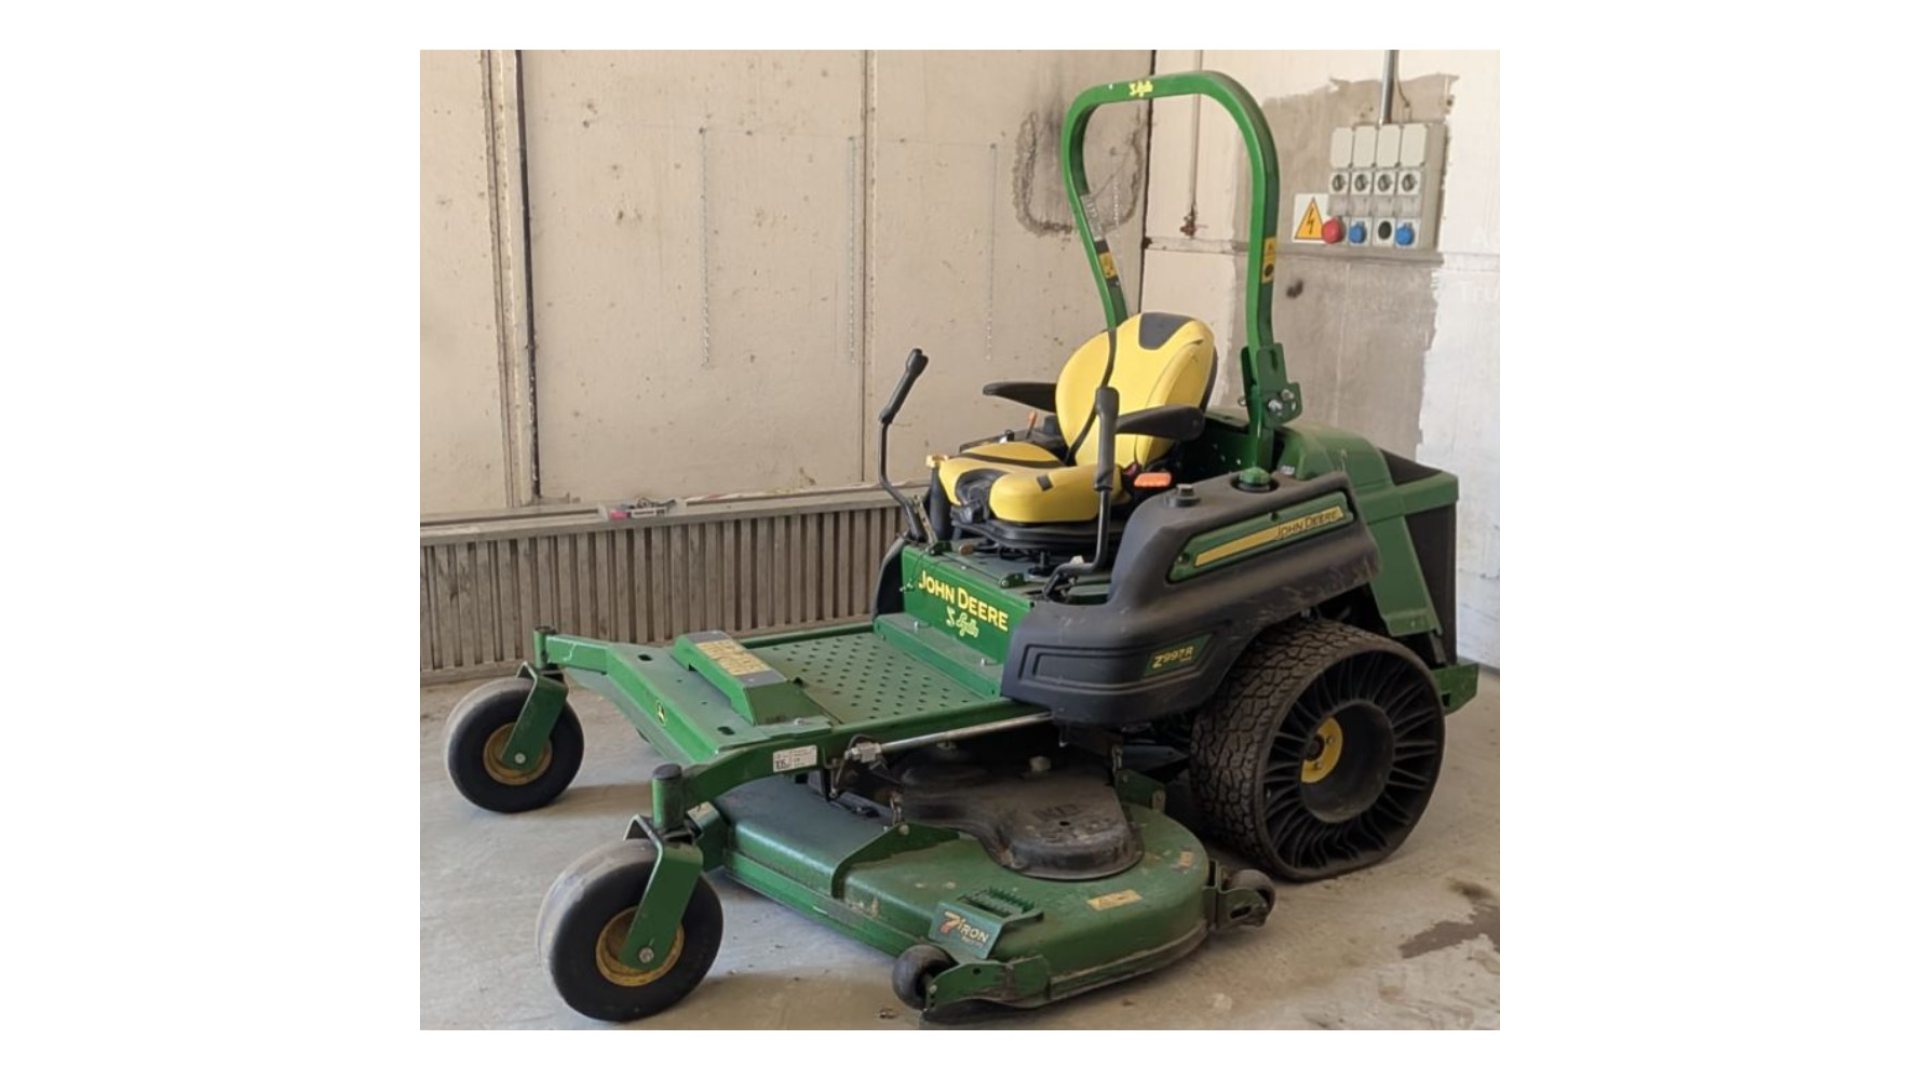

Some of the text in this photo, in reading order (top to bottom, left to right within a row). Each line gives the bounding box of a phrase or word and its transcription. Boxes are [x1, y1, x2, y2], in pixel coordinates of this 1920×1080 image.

[1275, 510, 1340, 539] JOHN DEERE
[918, 570, 955, 603] JOHN
[958, 588, 1009, 632] DEERE
[1152, 645, 1194, 669] Z997R
